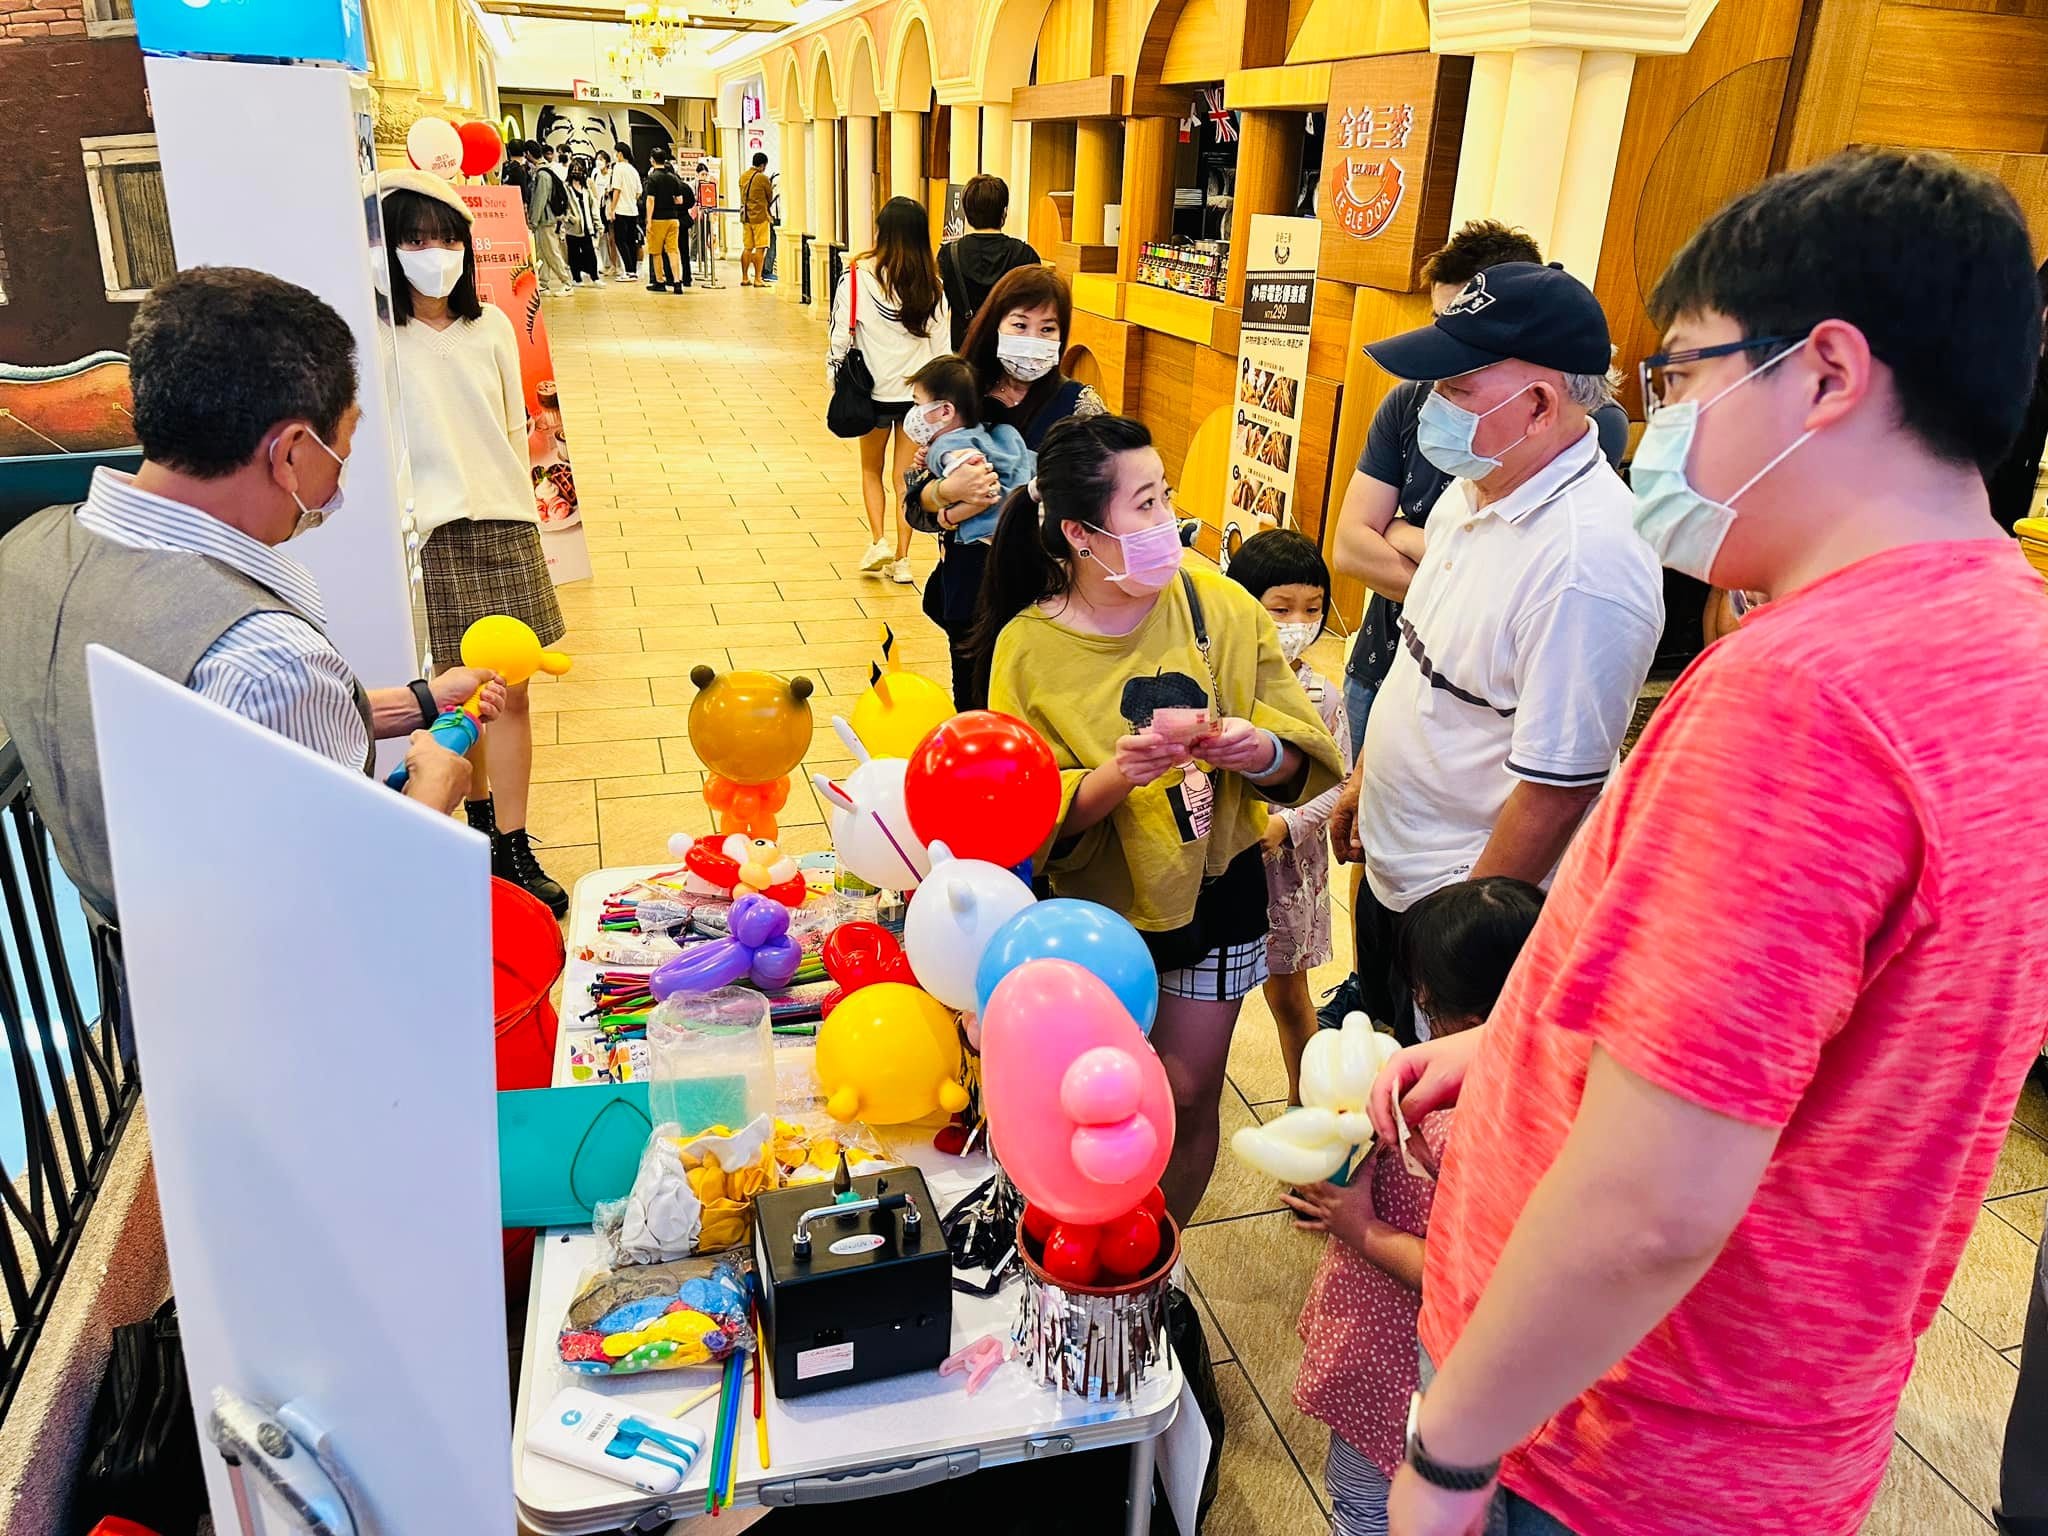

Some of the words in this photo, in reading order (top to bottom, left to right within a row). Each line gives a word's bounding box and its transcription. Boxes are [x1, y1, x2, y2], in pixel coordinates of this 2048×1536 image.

[1336, 103, 1414, 149] 金色三麥
[461, 195, 482, 208] ESSI
[484, 198, 507, 208] Store
[1335, 189, 1347, 215] LE
[1344, 207, 1363, 230] BLE
[475, 237, 492, 251] 88
